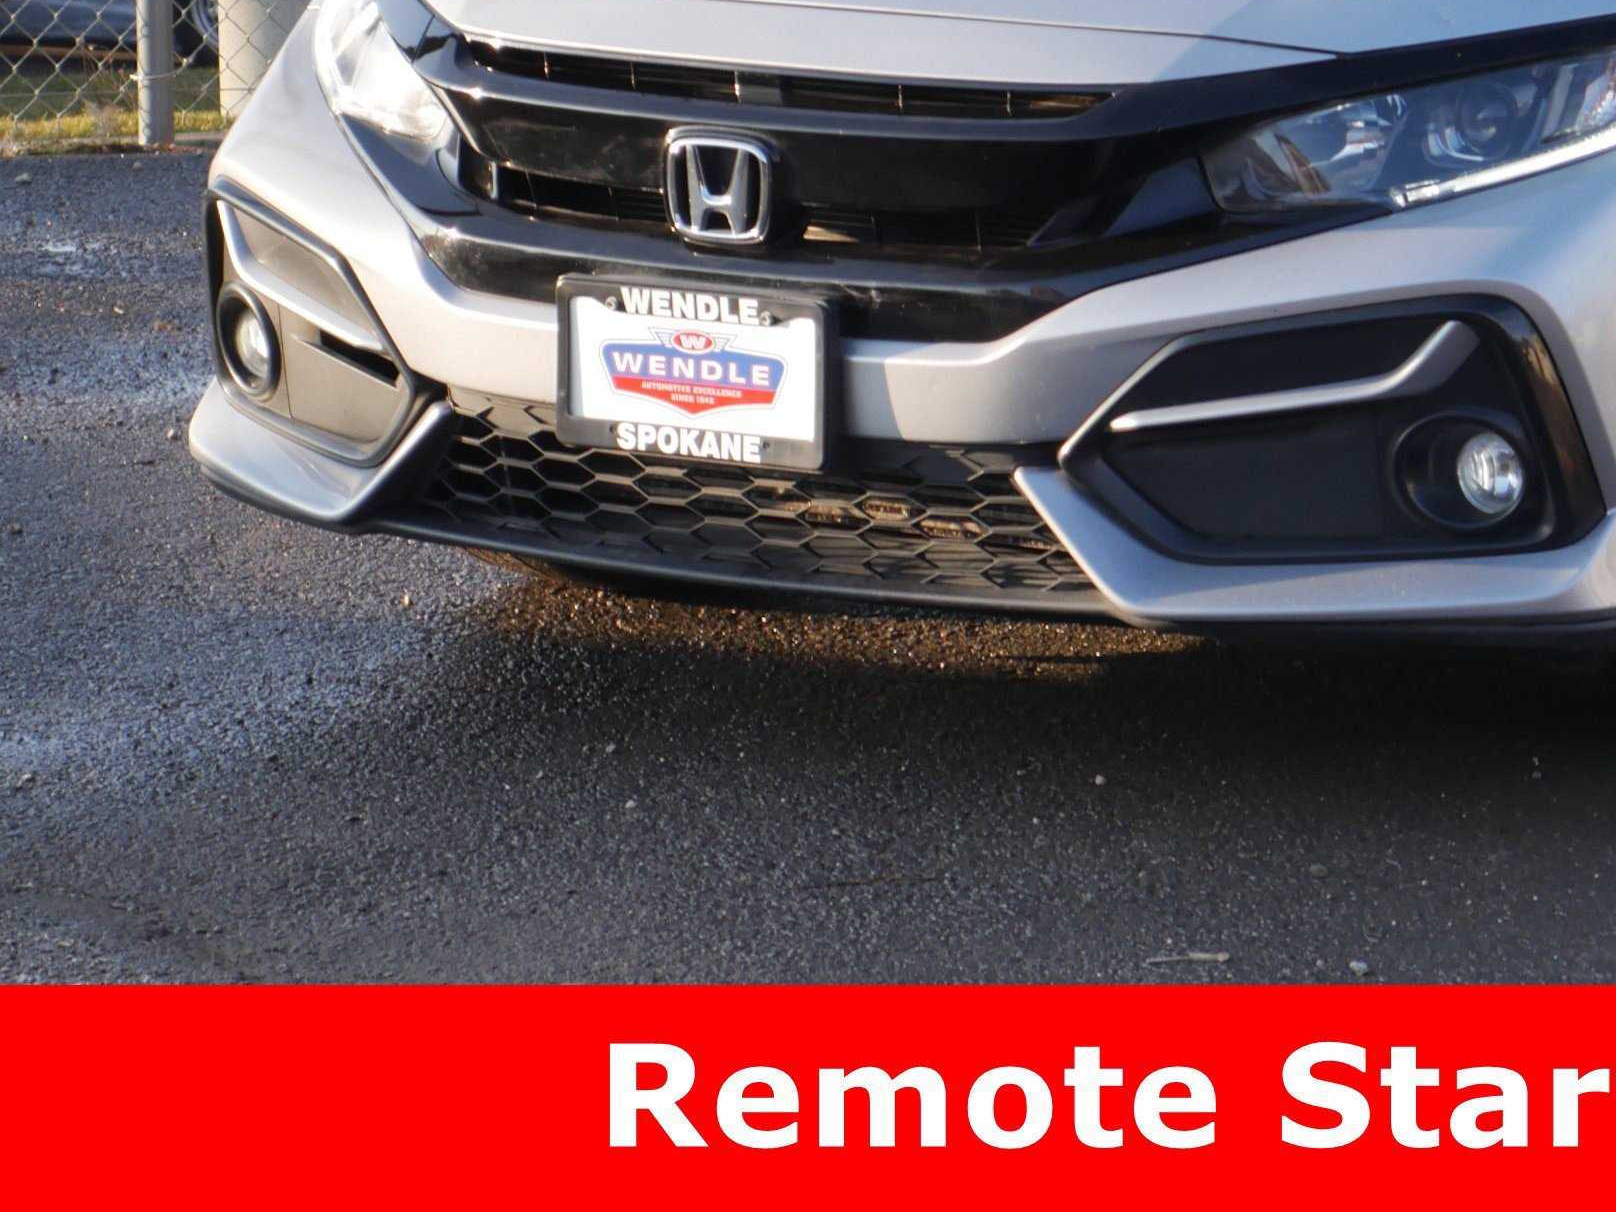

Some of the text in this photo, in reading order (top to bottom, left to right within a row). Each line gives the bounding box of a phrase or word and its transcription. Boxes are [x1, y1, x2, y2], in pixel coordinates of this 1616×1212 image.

[621, 286, 760, 325] WENDLE
[612, 350, 770, 386] WENDLE
[641, 380, 742, 399] AUTOMOTIVE EXCELLENCE
[616, 423, 761, 463] SPOKANE
